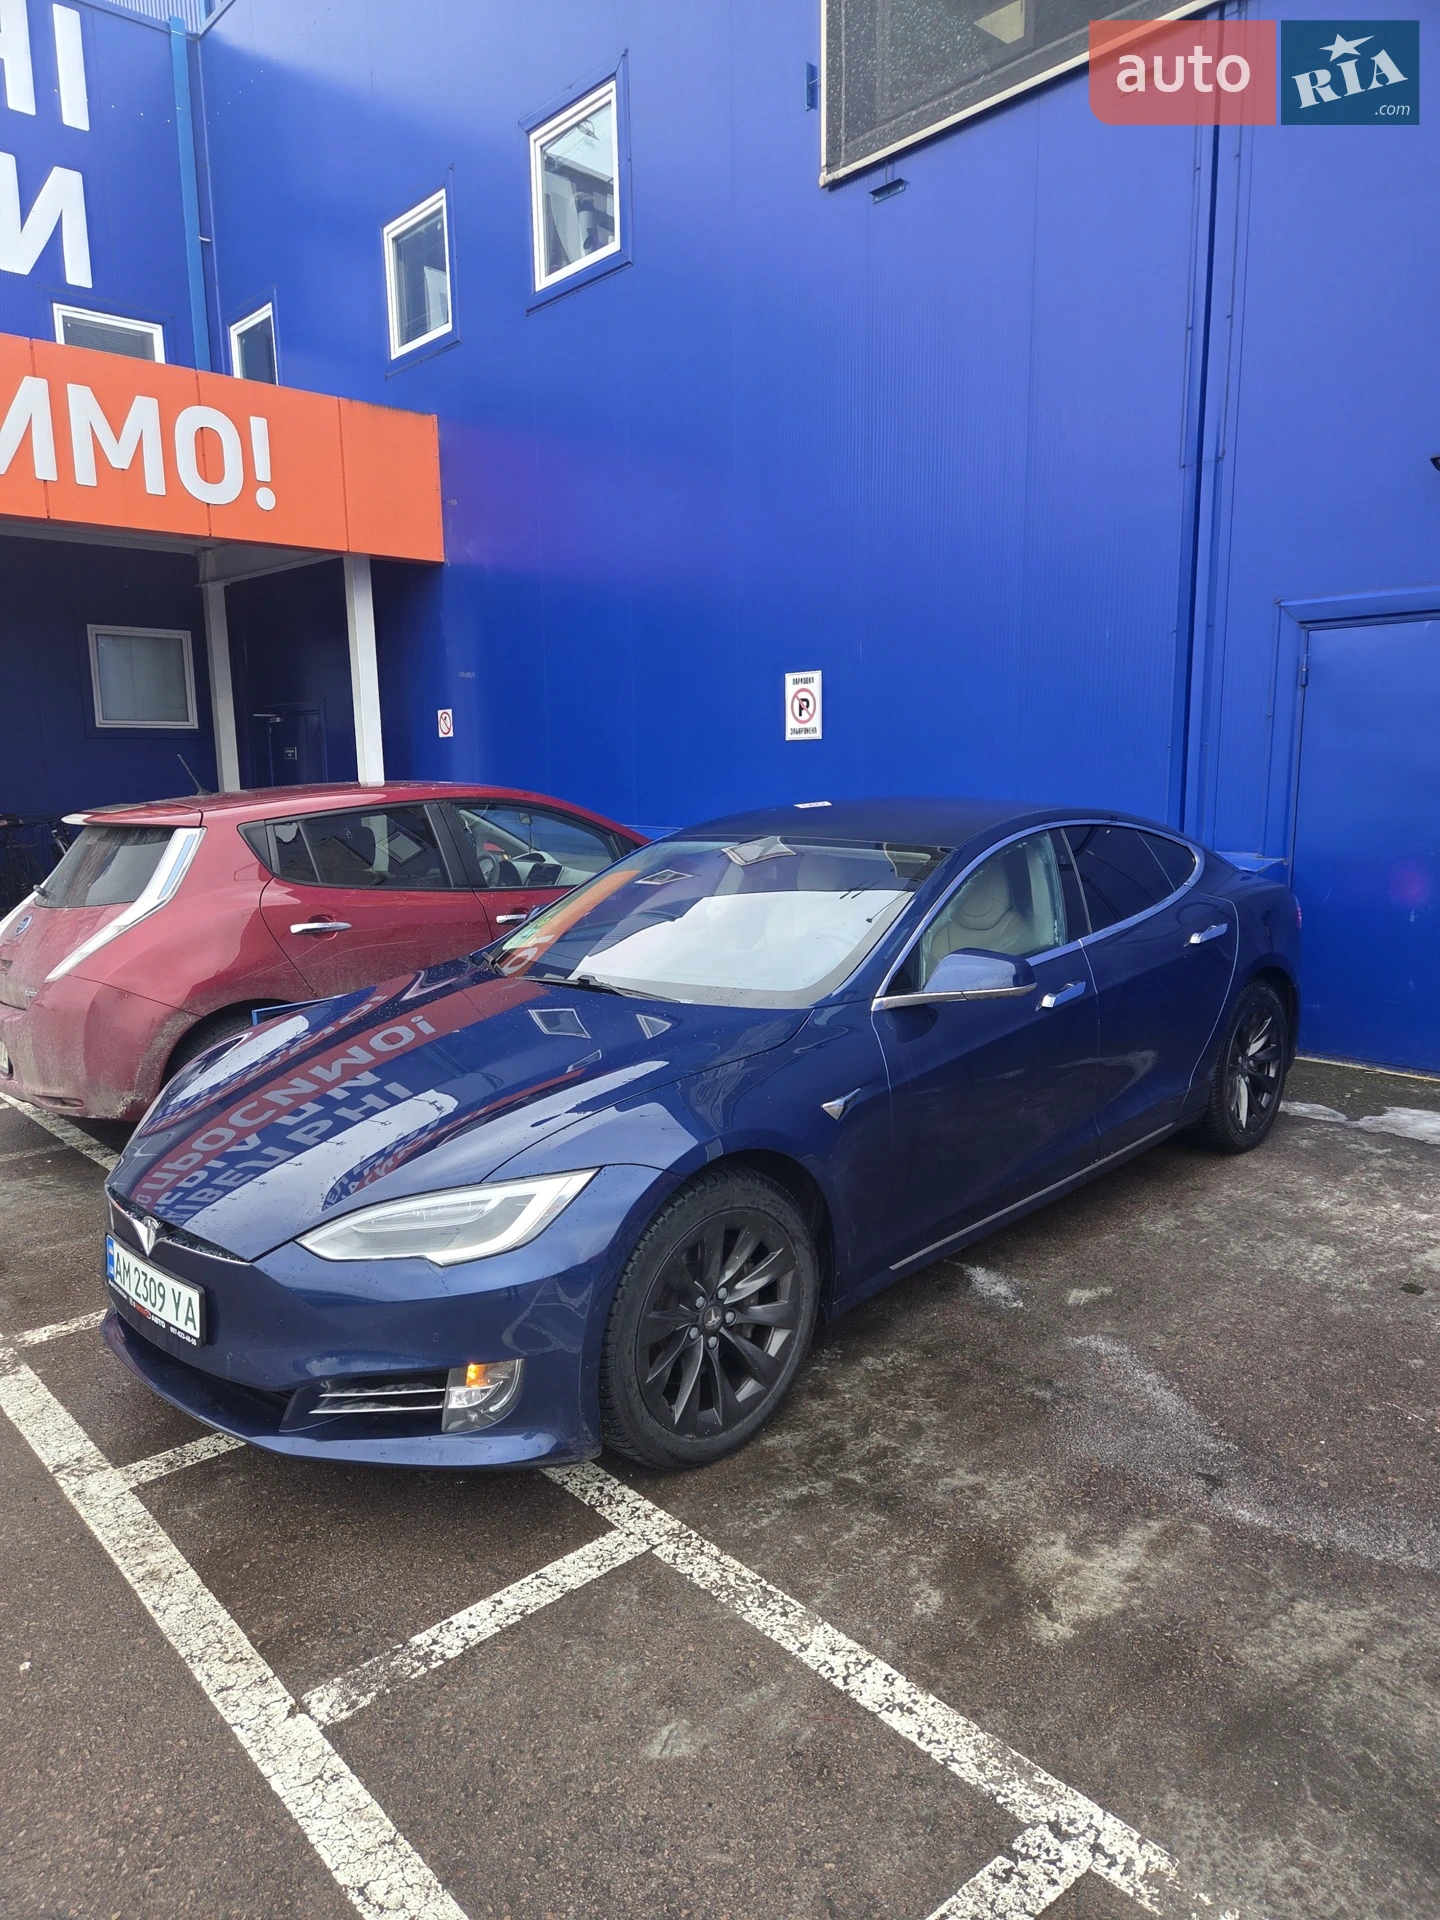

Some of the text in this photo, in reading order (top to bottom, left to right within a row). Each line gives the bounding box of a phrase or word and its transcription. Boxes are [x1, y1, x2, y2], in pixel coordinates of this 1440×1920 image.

[792, 676, 814, 685] ПАРКОВКА
[115, 1252, 132, 1292] AM
[133, 1266, 166, 1313] 2309
[171, 1288, 197, 1331] YA
